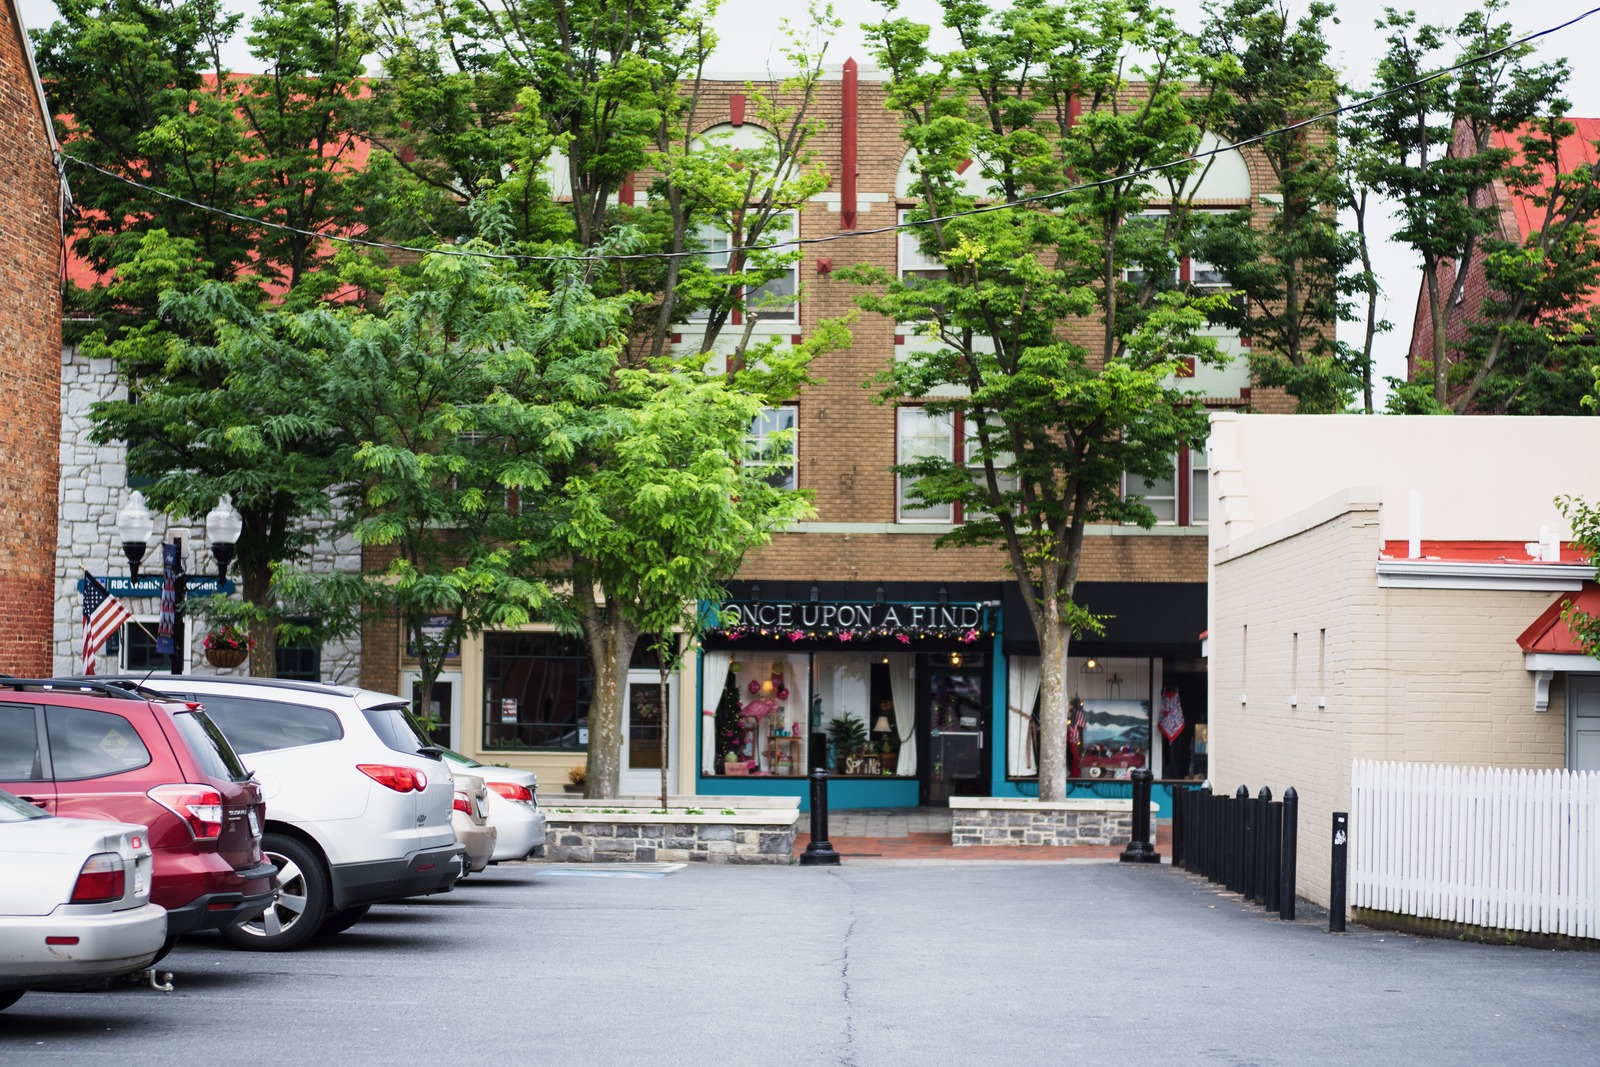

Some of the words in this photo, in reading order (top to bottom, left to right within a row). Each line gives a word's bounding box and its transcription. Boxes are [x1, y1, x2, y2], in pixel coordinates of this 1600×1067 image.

[111, 580, 128, 590] RBC
[724, 604, 794, 626] ONCE
[802, 605, 873, 627] UPON
[880, 606, 903, 627] A
[910, 606, 979, 628] FIND
